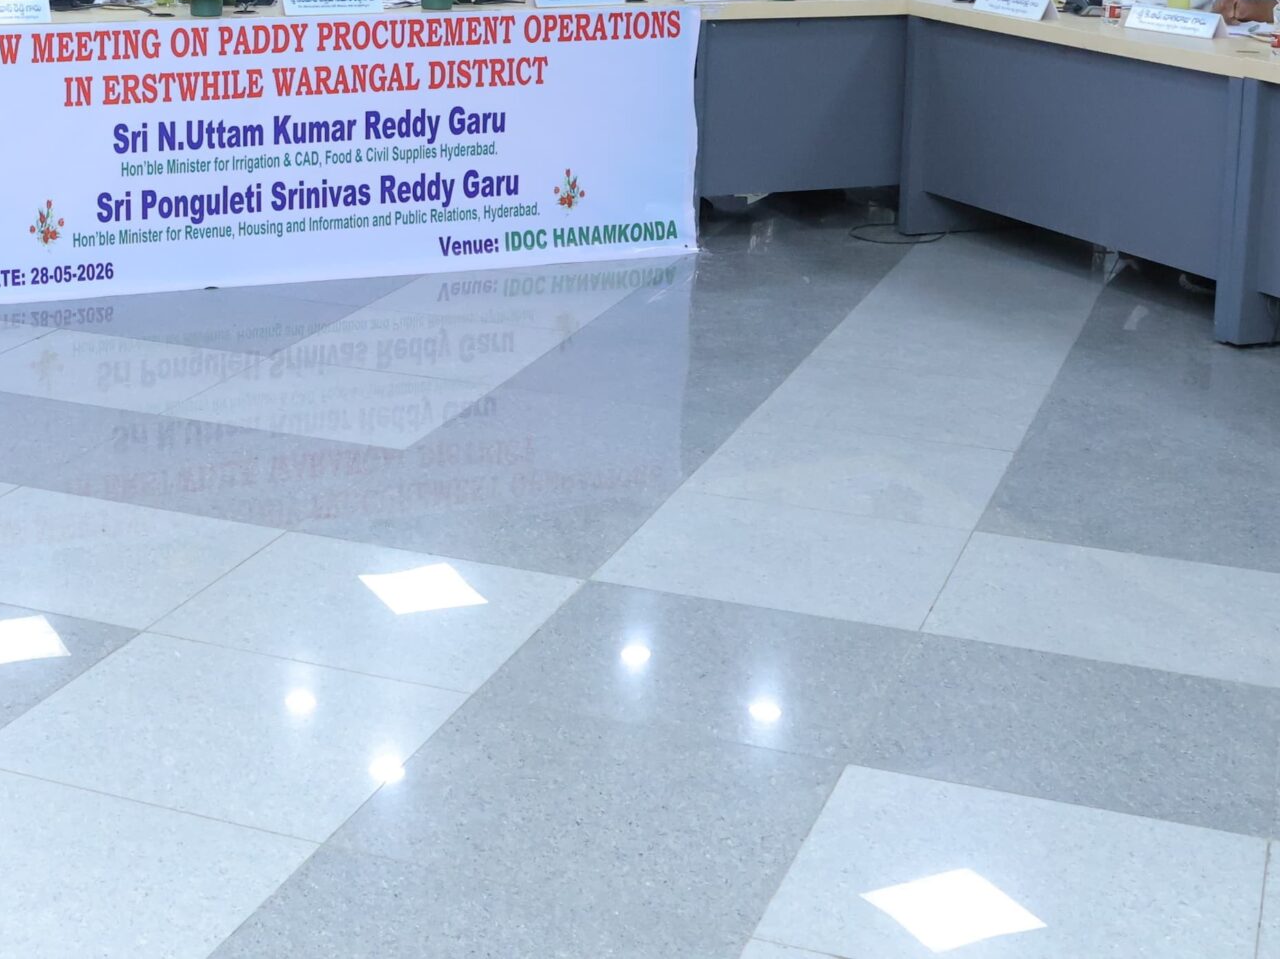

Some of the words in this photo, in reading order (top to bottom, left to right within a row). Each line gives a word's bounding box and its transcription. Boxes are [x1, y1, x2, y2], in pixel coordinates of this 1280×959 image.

[31, 29, 161, 63] MEETING
[171, 27, 209, 58] ON
[218, 23, 308, 56] PADDY
[317, 16, 516, 51] PROCUREMENT
[524, 10, 680, 43] OPERATIONS
[64, 76, 93, 107] IN
[103, 69, 264, 105] ERSTWHILE
[272, 62, 420, 96] WARANGAL
[428, 56, 548, 89] DISTRICT
[113, 123, 147, 154] Sri
[158, 120, 263, 151] N.Uttam
[274, 115, 357, 145] Kumar
[365, 109, 440, 143] Reddy
[449, 106, 506, 136] Garu
[121, 160, 163, 177] Hon'ble
[167, 159, 211, 174] Minister
[214, 157, 229, 172] for
[233, 154, 280, 172] Irrigation
[283, 153, 291, 167] &
[295, 151, 322, 167] CAD,
[325, 149, 352, 165] Food
[355, 148, 363, 163] &
[366, 147, 388, 162] Civil
[392, 143, 437, 164] Supplies
[440, 141, 497, 161] Hyderabad.
[97, 191, 131, 223] Sri
[142, 184, 261, 223] Ponguleti
[271, 179, 371, 211] Srinivas
[381, 172, 455, 207] Reddy
[463, 170, 519, 198] Garu
[73, 231, 115, 248] Hon'ble
[119, 229, 163, 244] Minister
[166, 226, 182, 241] for
[185, 223, 234, 240] Revenue,
[239, 220, 283, 237] Housing
[286, 217, 305, 233] and
[309, 214, 369, 231] Information
[372, 212, 391, 227] and
[395, 210, 427, 225] Public
[430, 207, 480, 223] Relations,
[484, 202, 540, 222] Hyderabad.
[439, 236, 499, 256] Venue:
[505, 229, 547, 251] IDOC
[553, 220, 677, 248] HANAMKONDA
[31, 262, 113, 285] 28-05-2026
